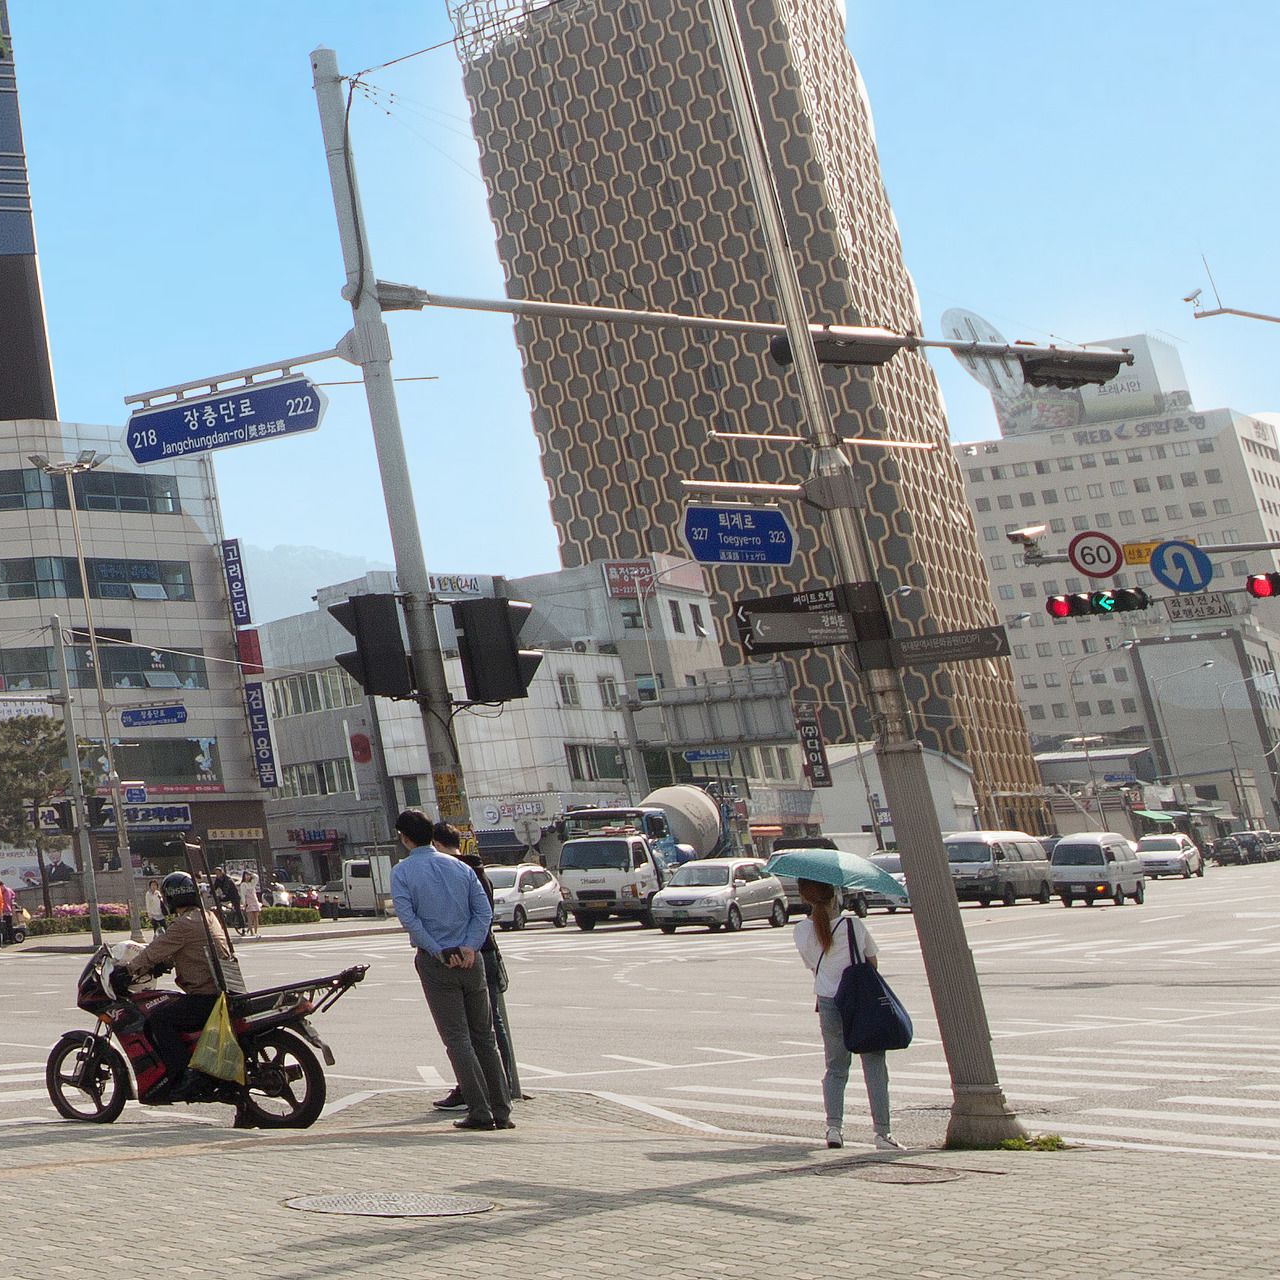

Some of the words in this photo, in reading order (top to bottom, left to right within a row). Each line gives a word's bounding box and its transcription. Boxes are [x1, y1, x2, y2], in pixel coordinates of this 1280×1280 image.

[132, 429, 158, 450] 218
[183, 398, 256, 431] 장충단로
[286, 395, 315, 417] 222
[692, 528, 708, 542] 327
[718, 532, 762, 547] Toegye-ro
[768, 531, 786, 544] 323
[718, 513, 756, 531] 퇴계로
[1080, 544, 1111, 566] 60
[224, 545, 247, 619] 고려은단
[247, 688, 276, 784] 검도용품
